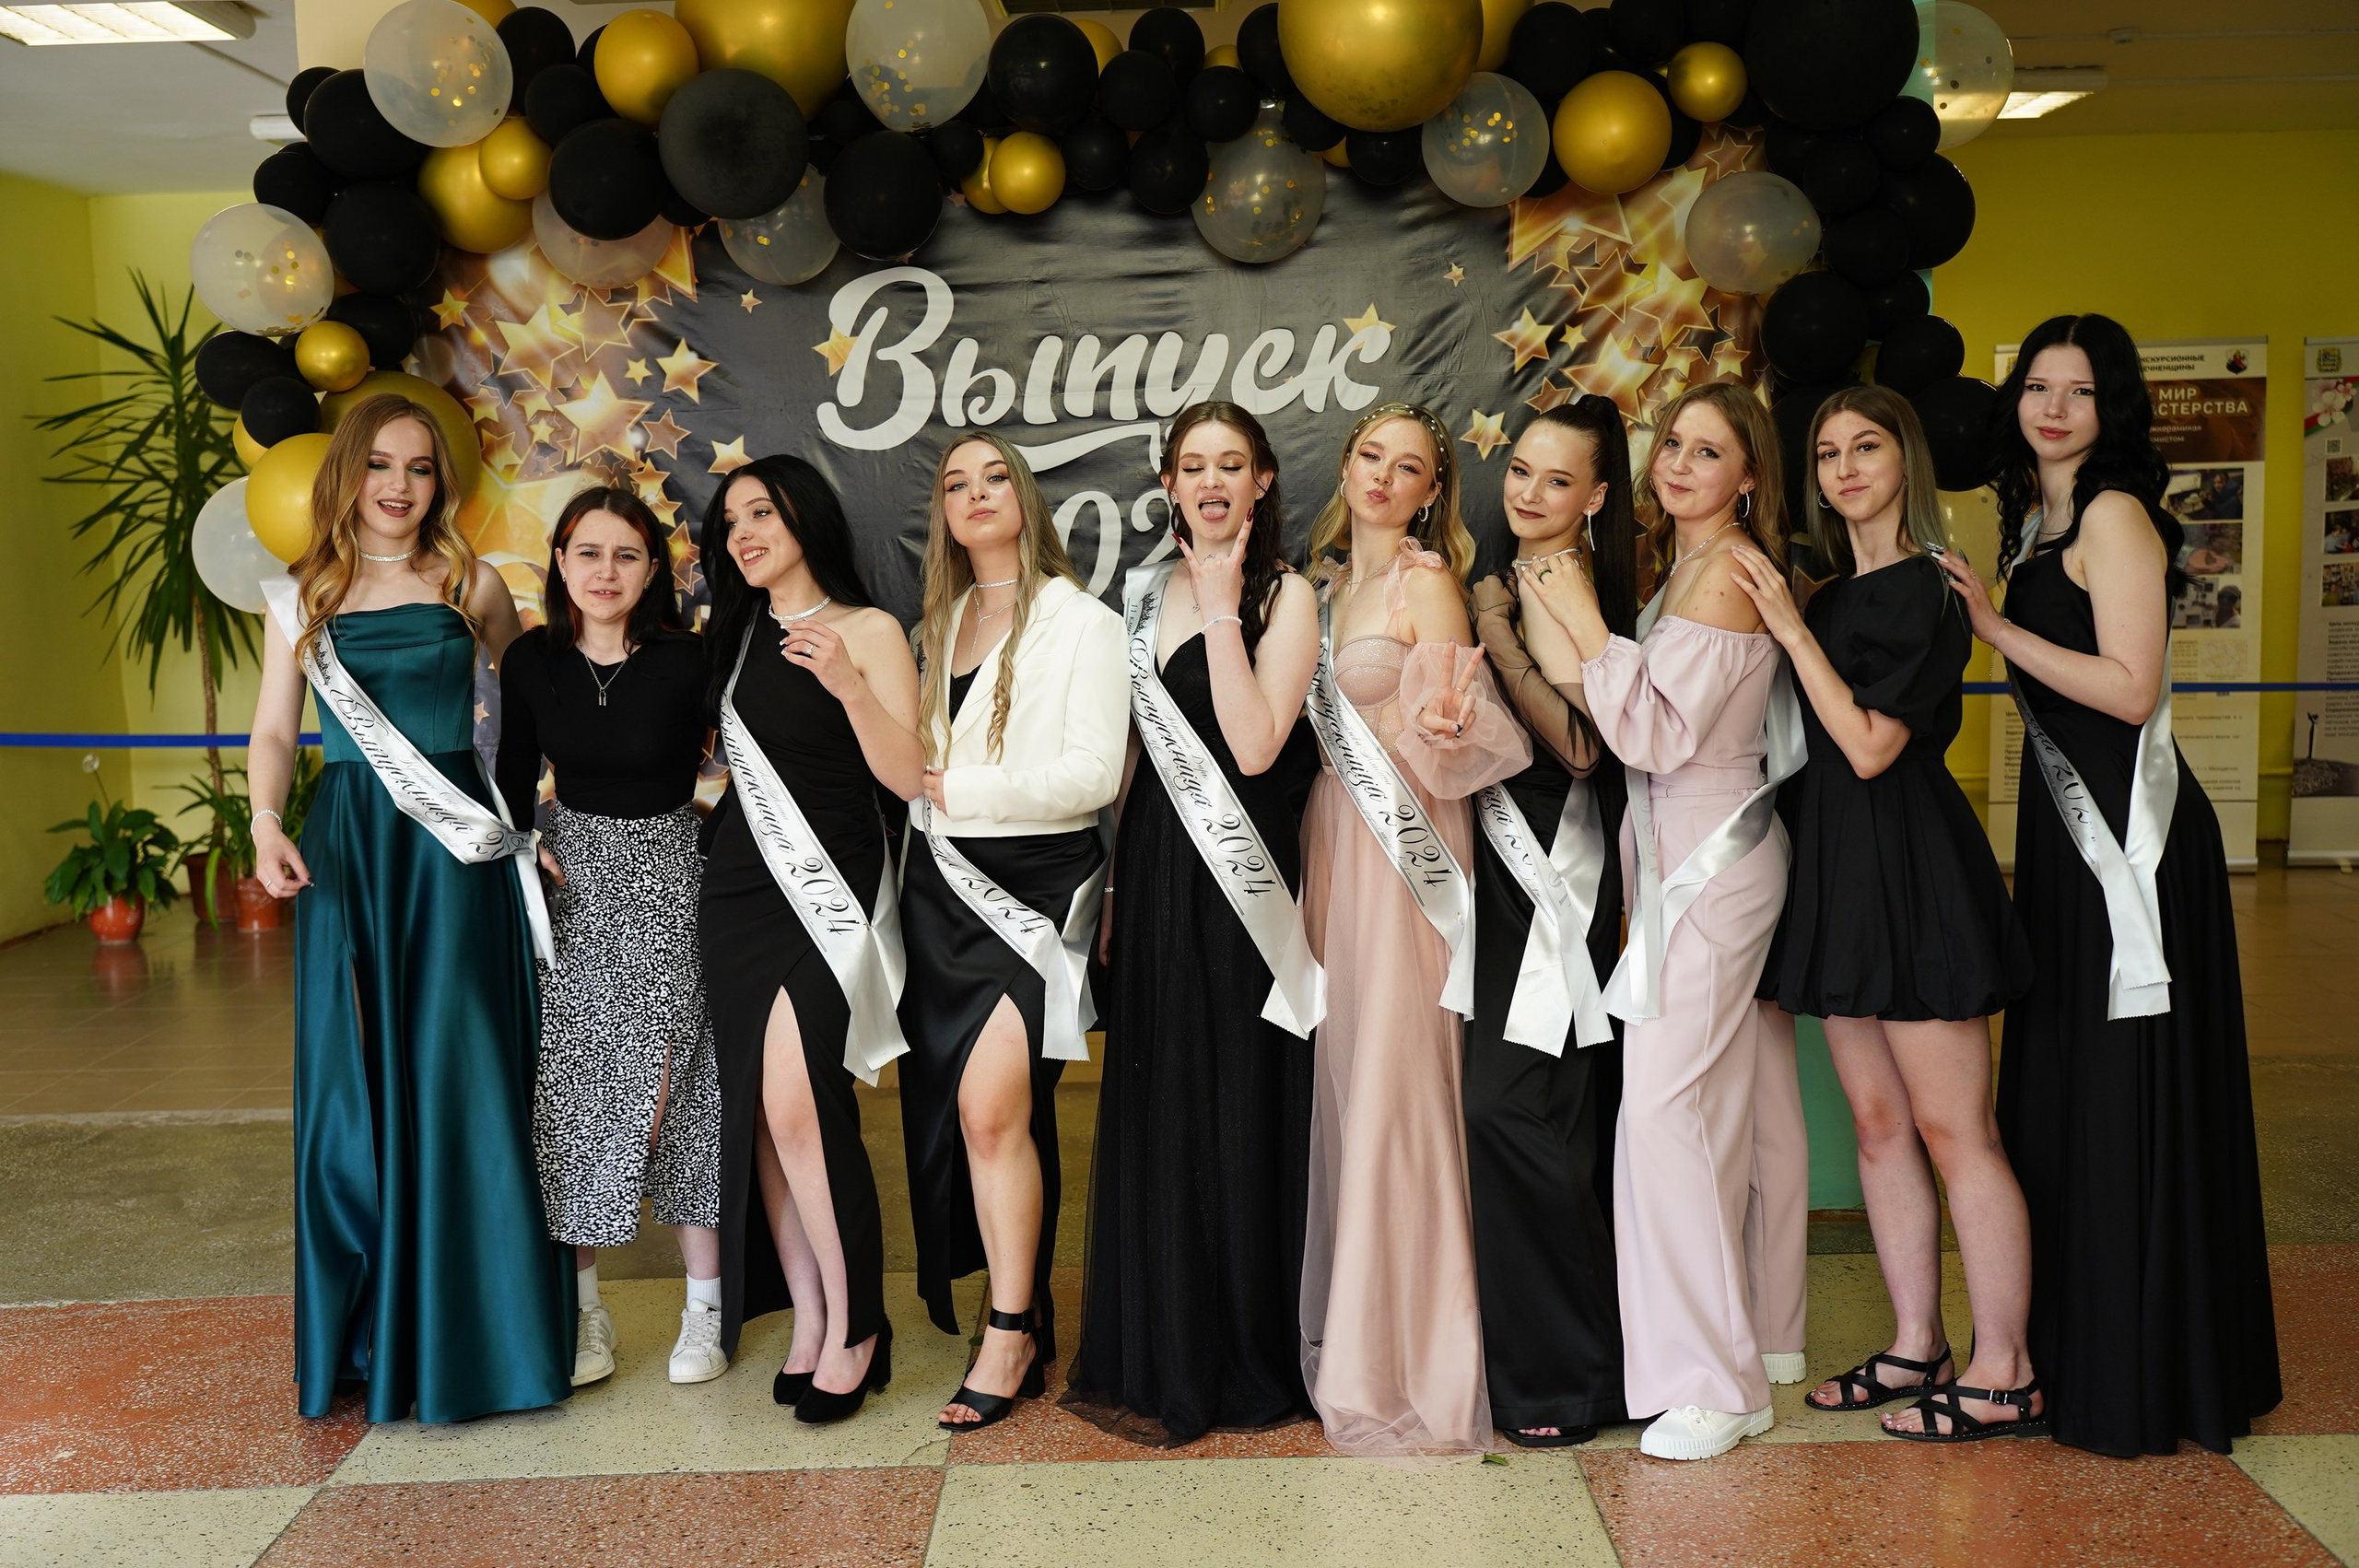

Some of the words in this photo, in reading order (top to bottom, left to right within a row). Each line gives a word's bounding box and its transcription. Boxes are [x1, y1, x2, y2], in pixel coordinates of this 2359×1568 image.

[816, 266, 1393, 470] Выпуск
[2158, 388, 2197, 401] МИР
[327, 688, 473, 837] Выпускница
[1126, 638, 1215, 811] Выпускница
[1201, 811, 1277, 895] 2024
[784, 857, 861, 935] 2024
[1379, 804, 1453, 885] 2024
